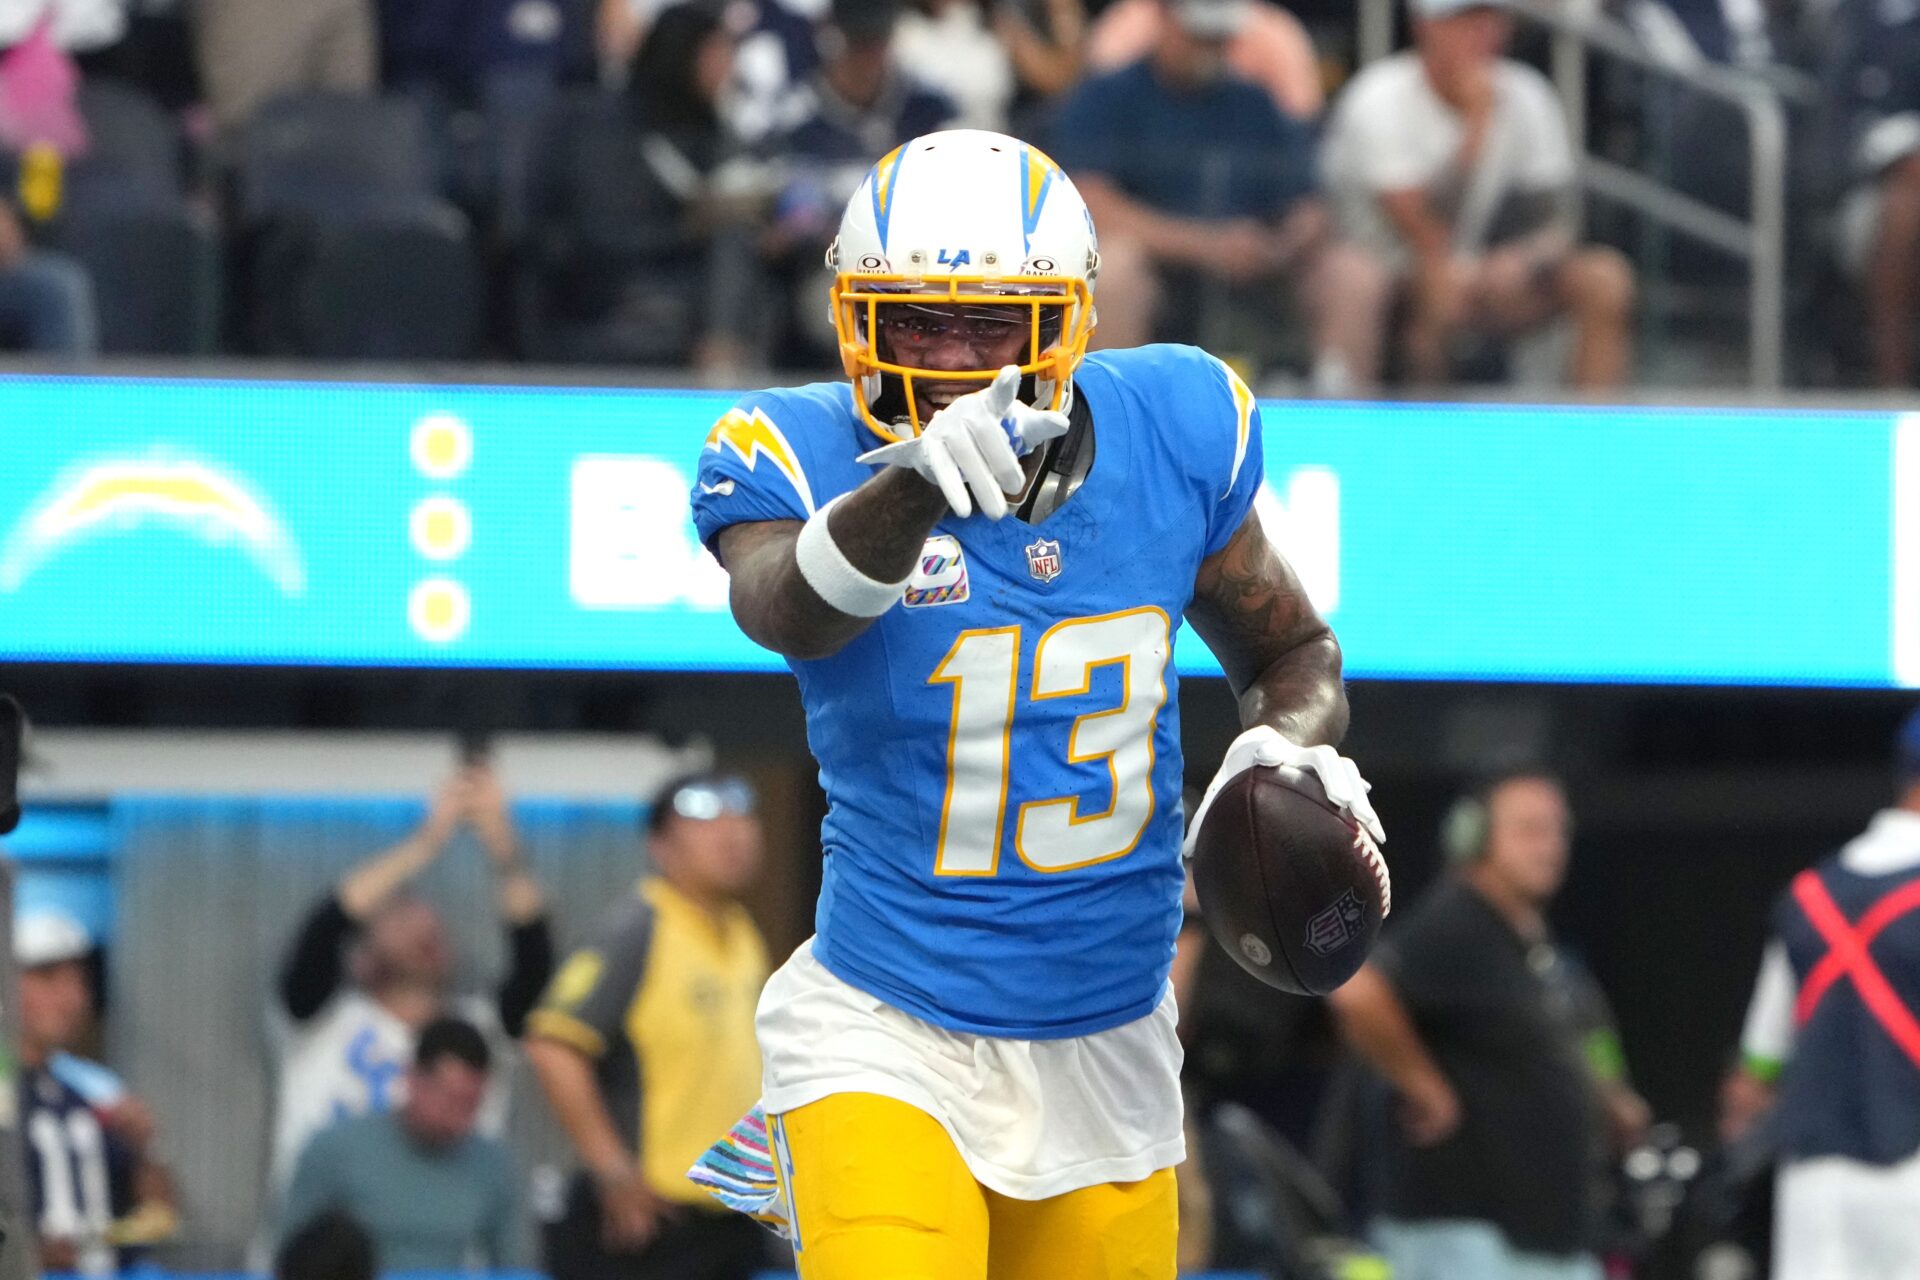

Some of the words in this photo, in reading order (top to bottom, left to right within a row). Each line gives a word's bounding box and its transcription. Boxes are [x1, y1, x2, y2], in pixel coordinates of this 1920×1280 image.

[937, 249, 970, 272] LA
[1033, 556, 1058, 575] NFL
[928, 605, 1171, 876] 13
